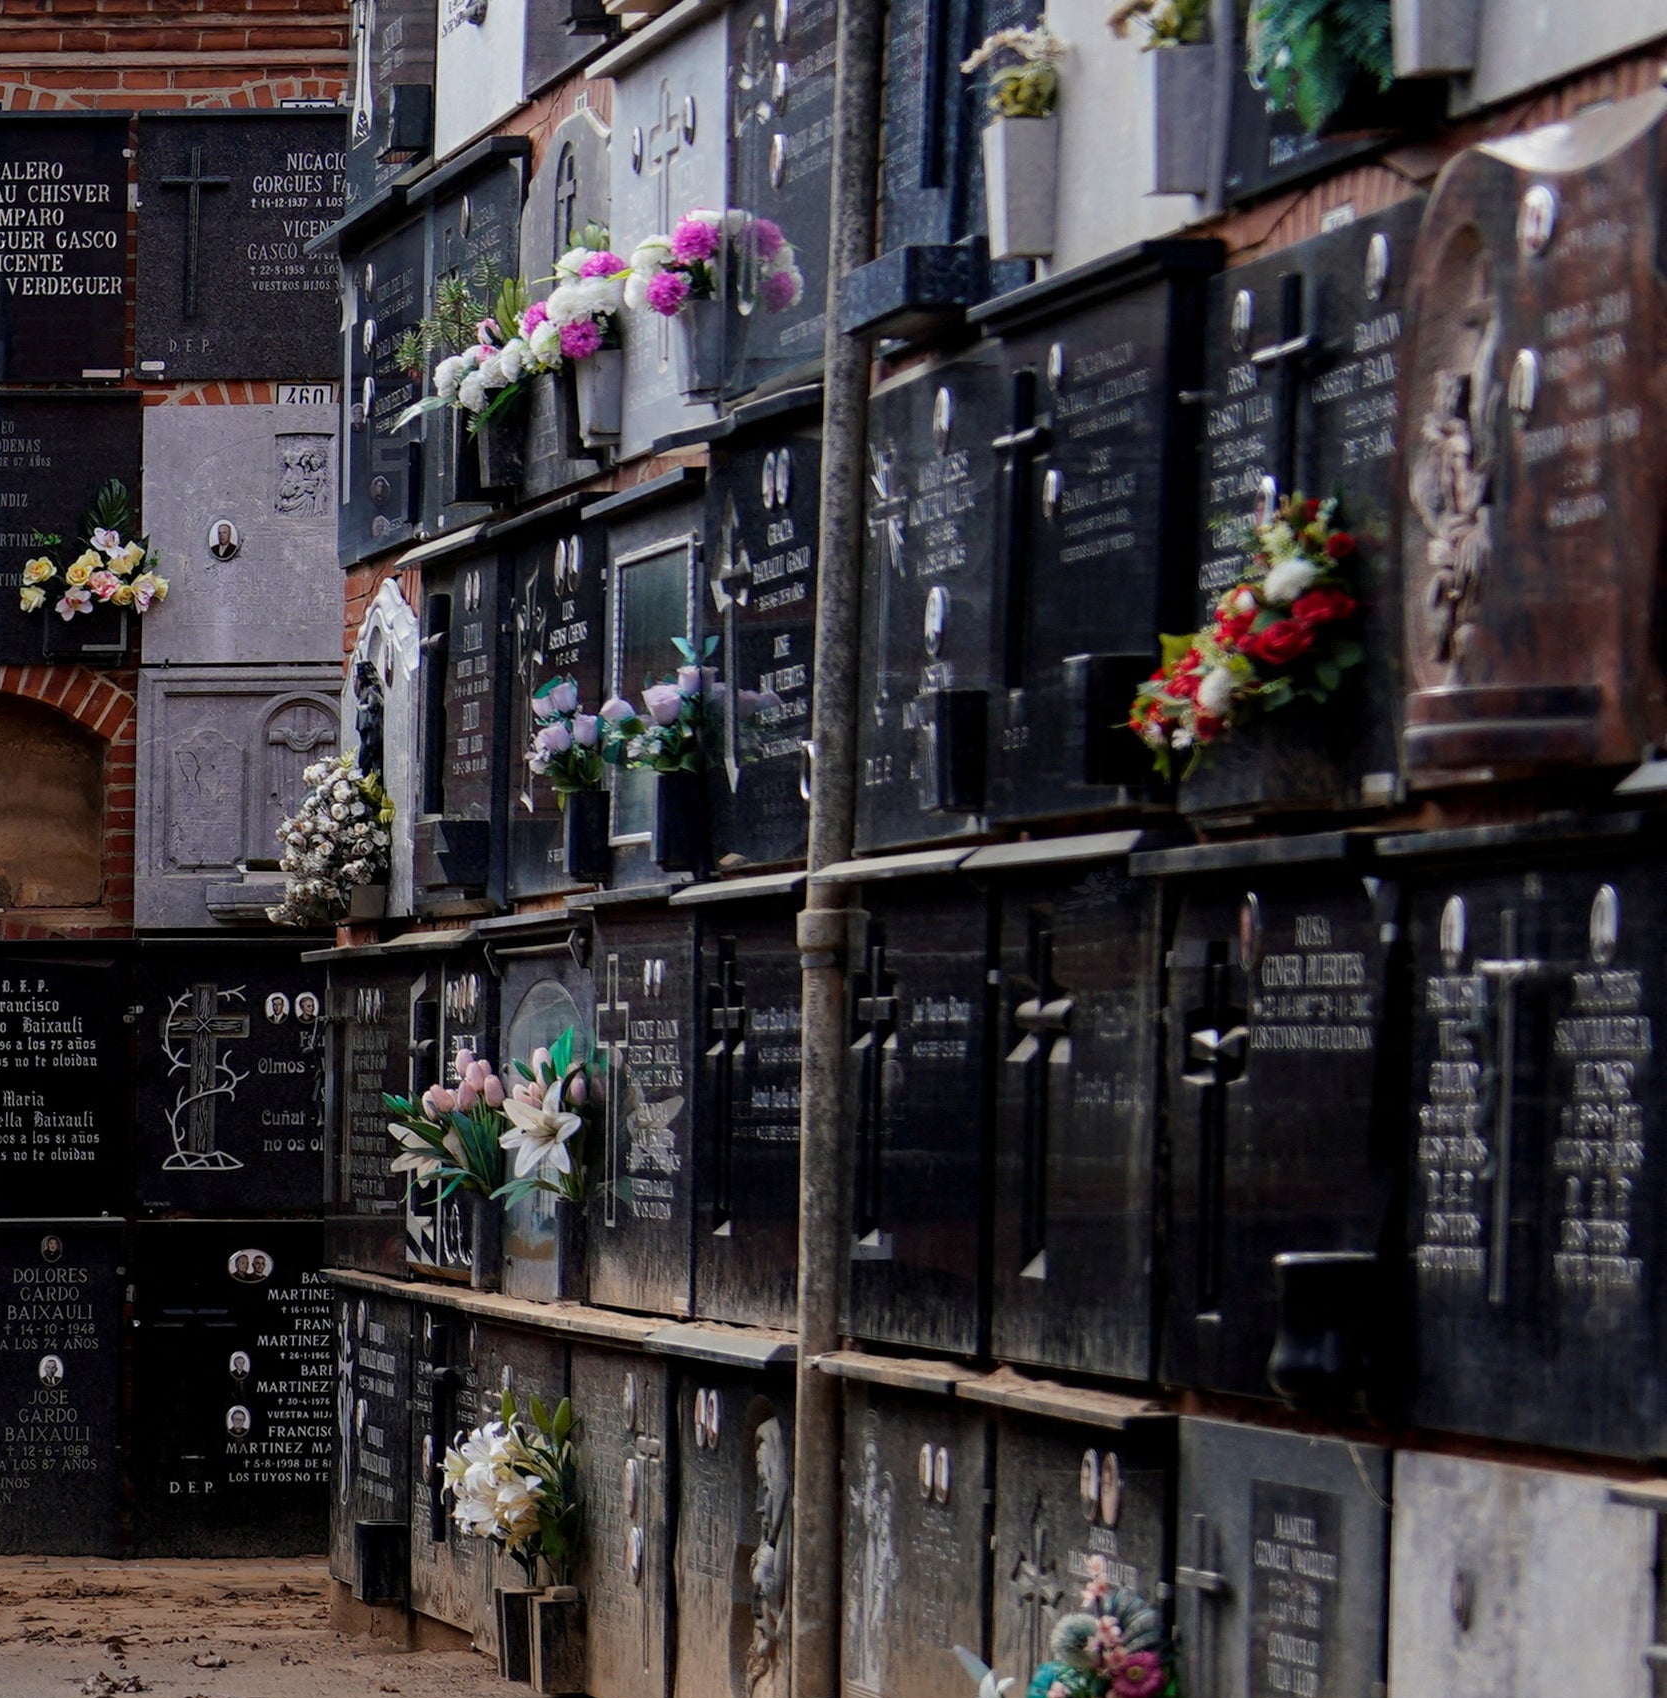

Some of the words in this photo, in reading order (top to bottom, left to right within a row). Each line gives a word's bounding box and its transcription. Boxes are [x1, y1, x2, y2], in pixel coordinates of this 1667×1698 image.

[27, 184, 110, 203] CHISVER
[55, 230, 117, 249] GASCO
[5, 276, 122, 296] VERDEGUER
[13, 1267, 88, 1284] DOLORES
[19, 1286, 80, 1302] GARDO
[7, 1303, 93, 1321] BAIXAULI
[28, 1389, 69, 1405] JOSE
[18, 1407, 78, 1424] GARDO
[4, 1425, 91, 1442] BAIXAULI
